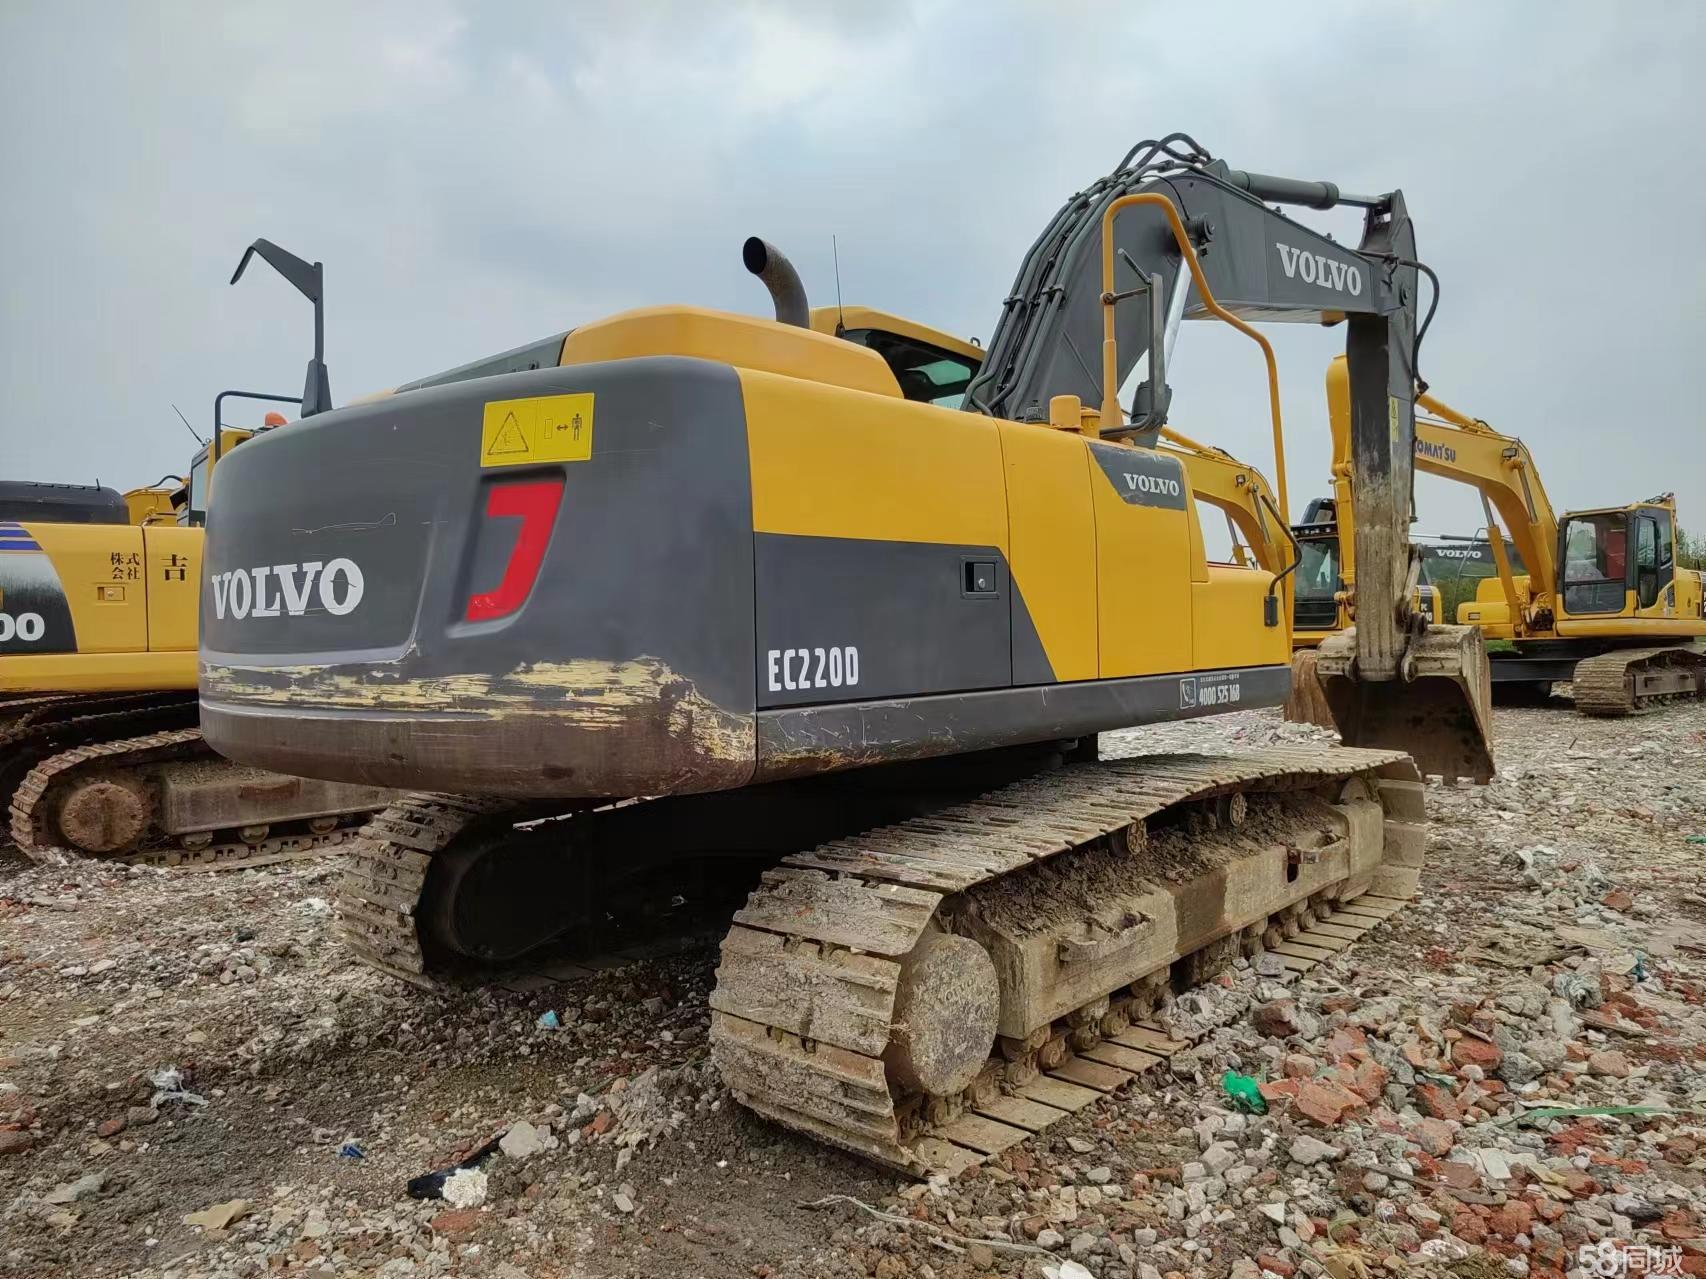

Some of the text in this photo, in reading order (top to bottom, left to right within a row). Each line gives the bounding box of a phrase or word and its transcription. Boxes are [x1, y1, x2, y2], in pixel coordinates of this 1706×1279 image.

[1276, 242, 1362, 296] VOLVO
[1415, 439, 1456, 463] OMATSU
[1124, 472, 1180, 497] VOLVO
[110, 551, 140, 566] 株式
[1436, 549, 1482, 559] VOLVO
[112, 566, 140, 580] 会社
[161, 554, 188, 581] 吉
[211, 557, 364, 620] VOLVO
[768, 646, 859, 692] EC220D
[1199, 687, 1216, 706] 4000
[1230, 683, 1240, 702] 168
